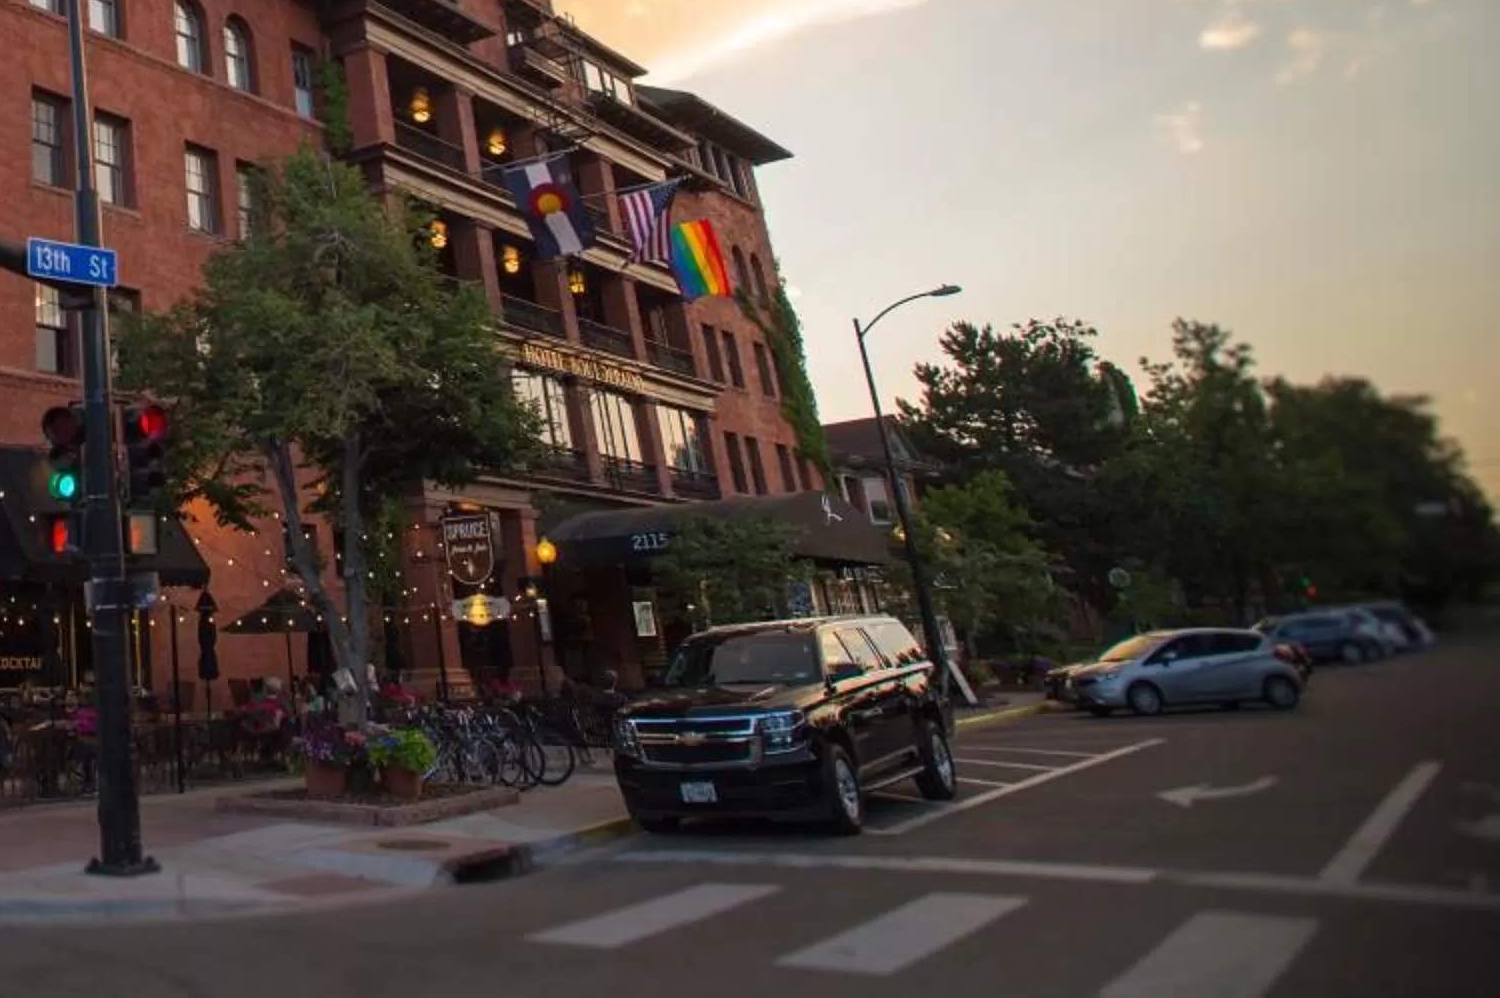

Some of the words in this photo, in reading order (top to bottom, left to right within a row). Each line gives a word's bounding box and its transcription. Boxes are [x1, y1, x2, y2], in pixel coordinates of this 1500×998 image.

[35, 245, 71, 274] 13th
[89, 254, 108, 278] St
[631, 533, 669, 551] 2115
